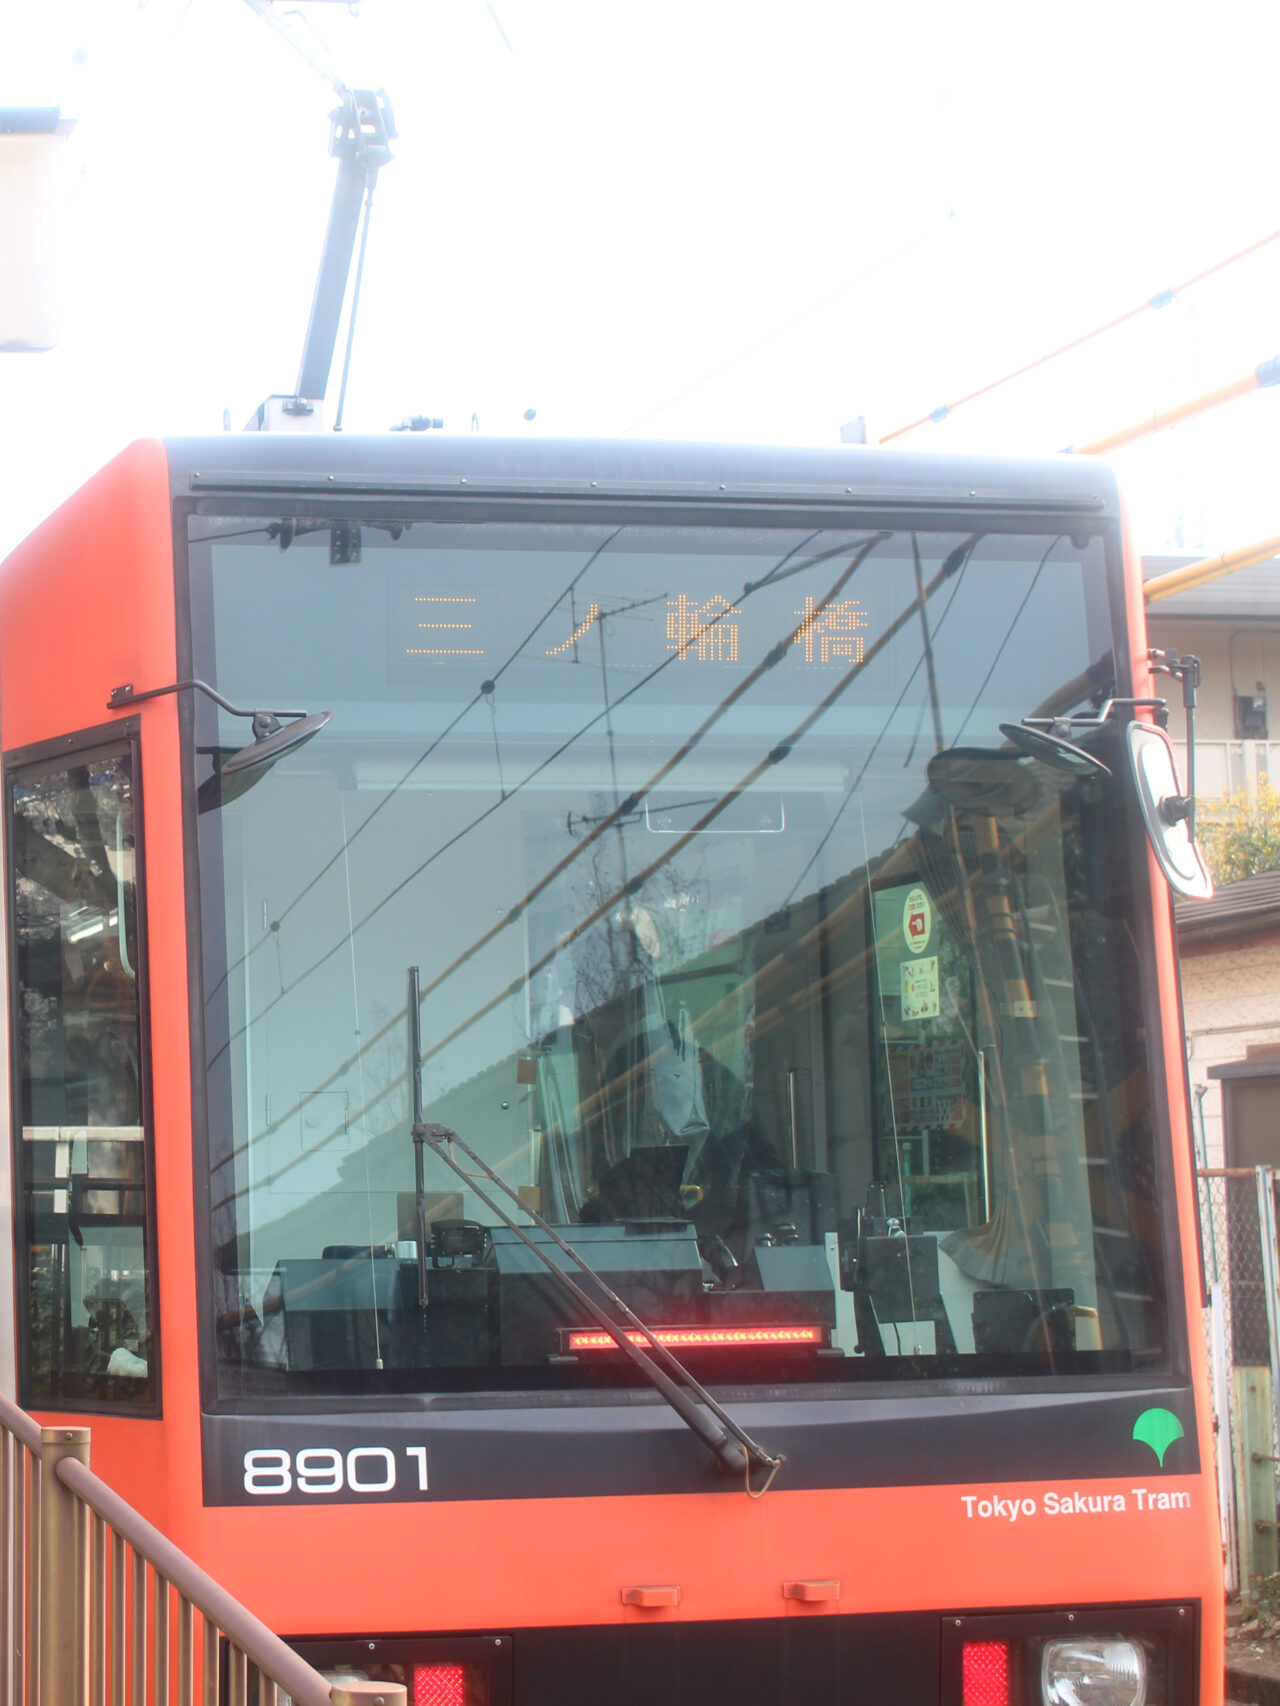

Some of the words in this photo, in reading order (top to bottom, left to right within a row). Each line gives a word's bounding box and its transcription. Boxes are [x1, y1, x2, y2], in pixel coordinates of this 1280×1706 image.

[406, 593, 868, 664] 三ノ輪橋
[243, 1446, 429, 1495] 8901
[961, 1495, 1037, 1522] Tokyo
[1043, 1491, 1127, 1516] Sakura
[1131, 1488, 1192, 1511] Tram
